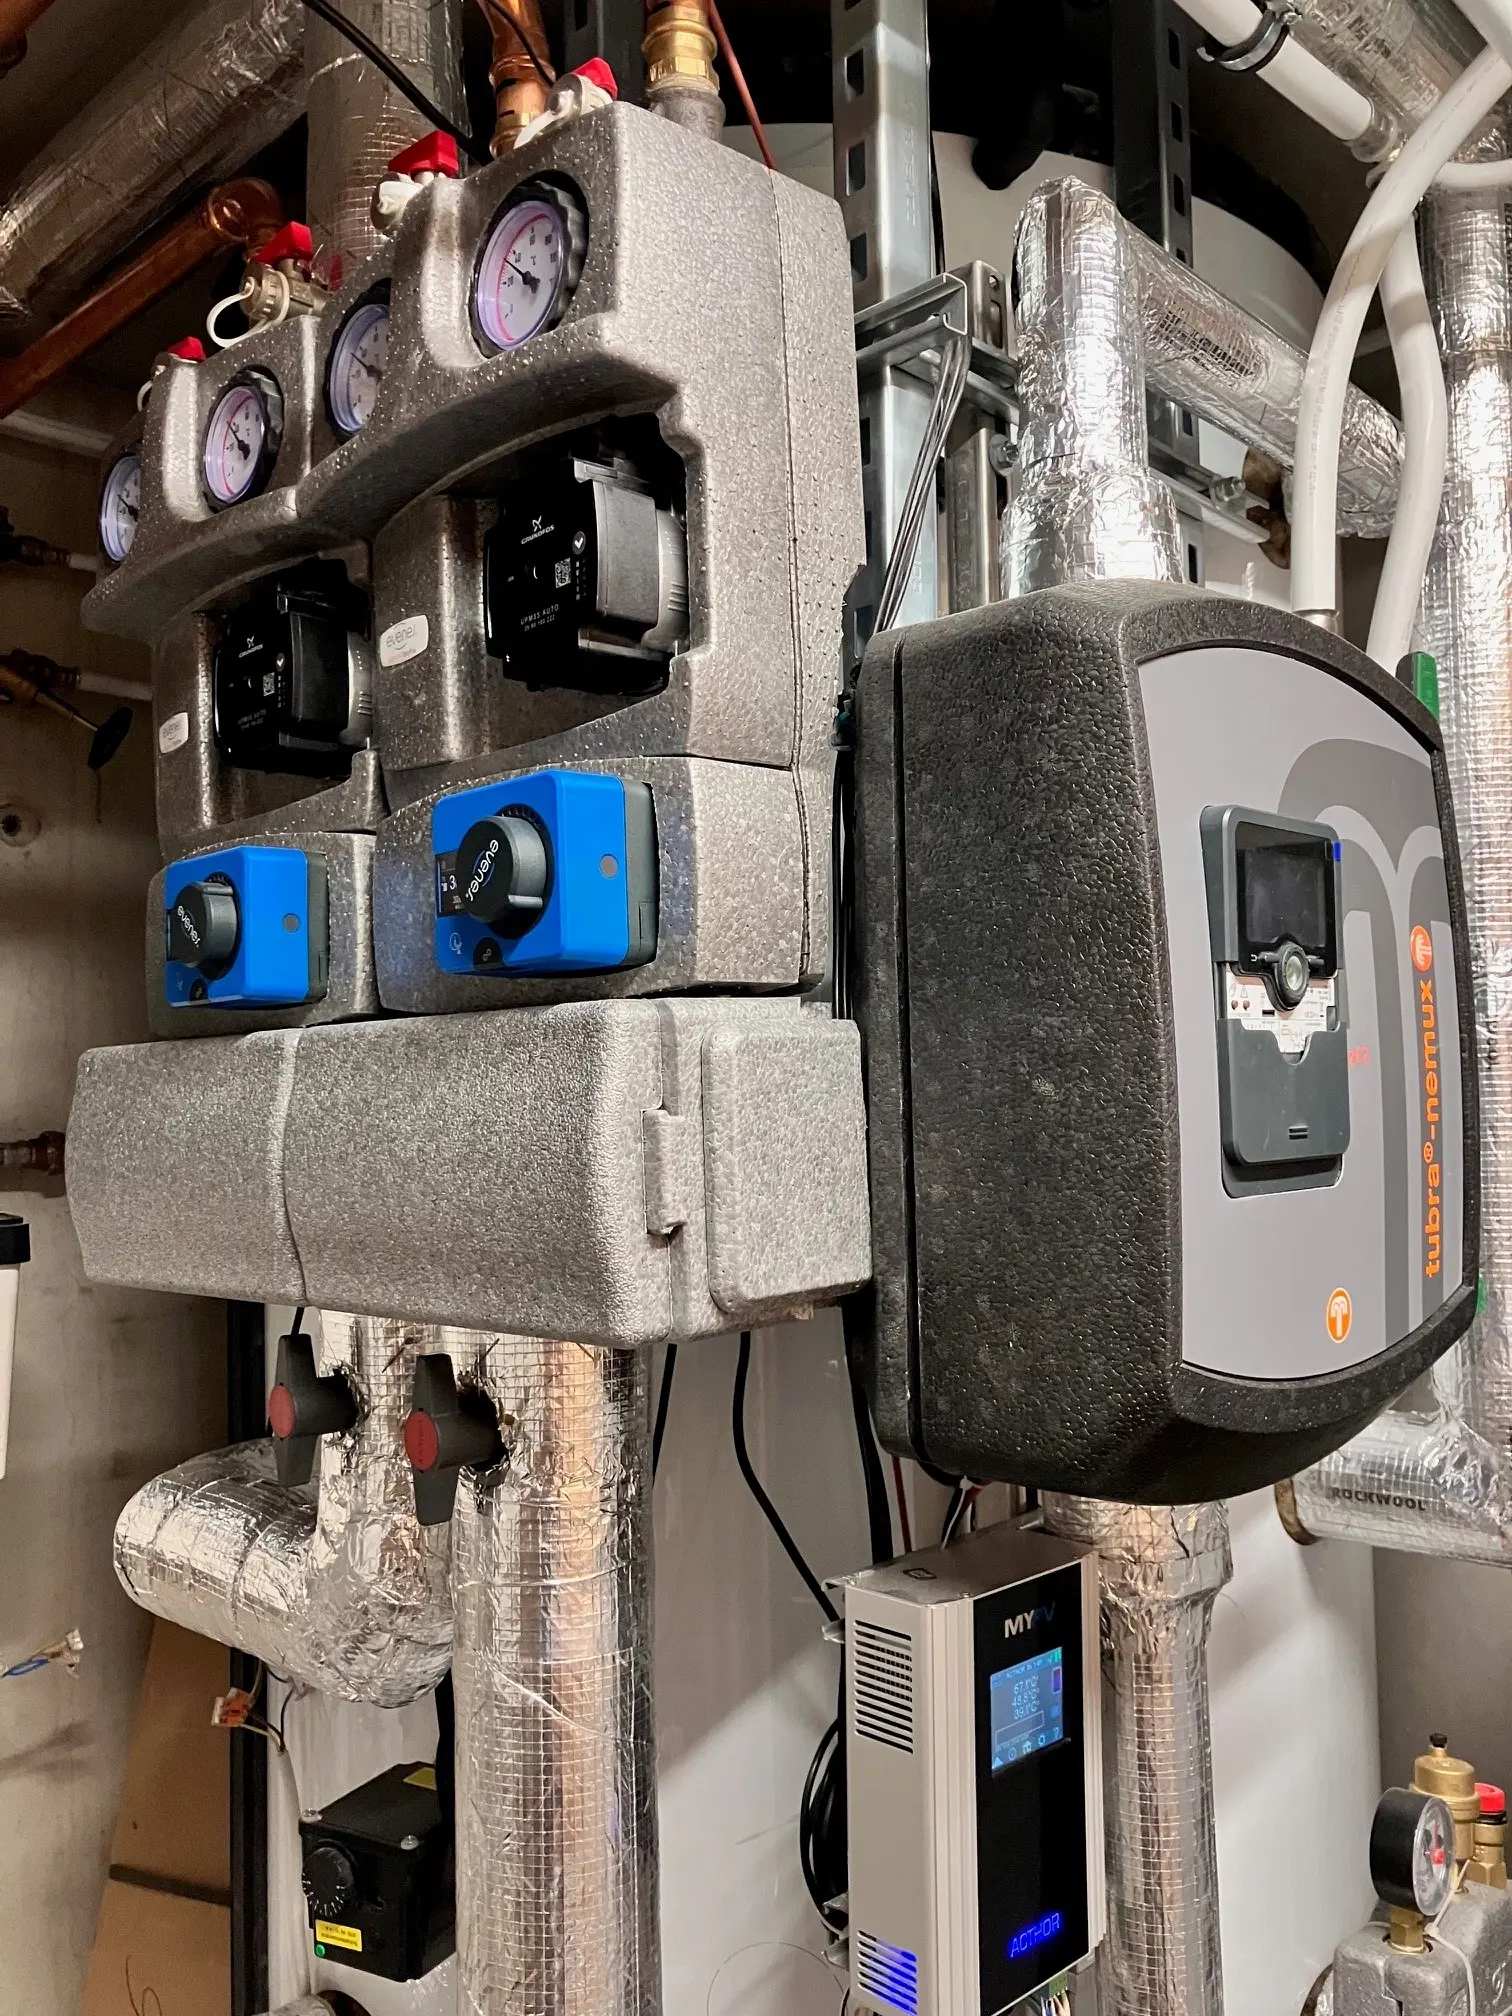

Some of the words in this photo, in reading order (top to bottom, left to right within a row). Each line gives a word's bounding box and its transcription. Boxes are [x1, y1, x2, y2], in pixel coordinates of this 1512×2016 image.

[542, 603, 559, 617] AUTO
[1330, 1486, 1427, 1511] ROCKWOOL
[1010, 1912, 1060, 1958] ACTHOR
